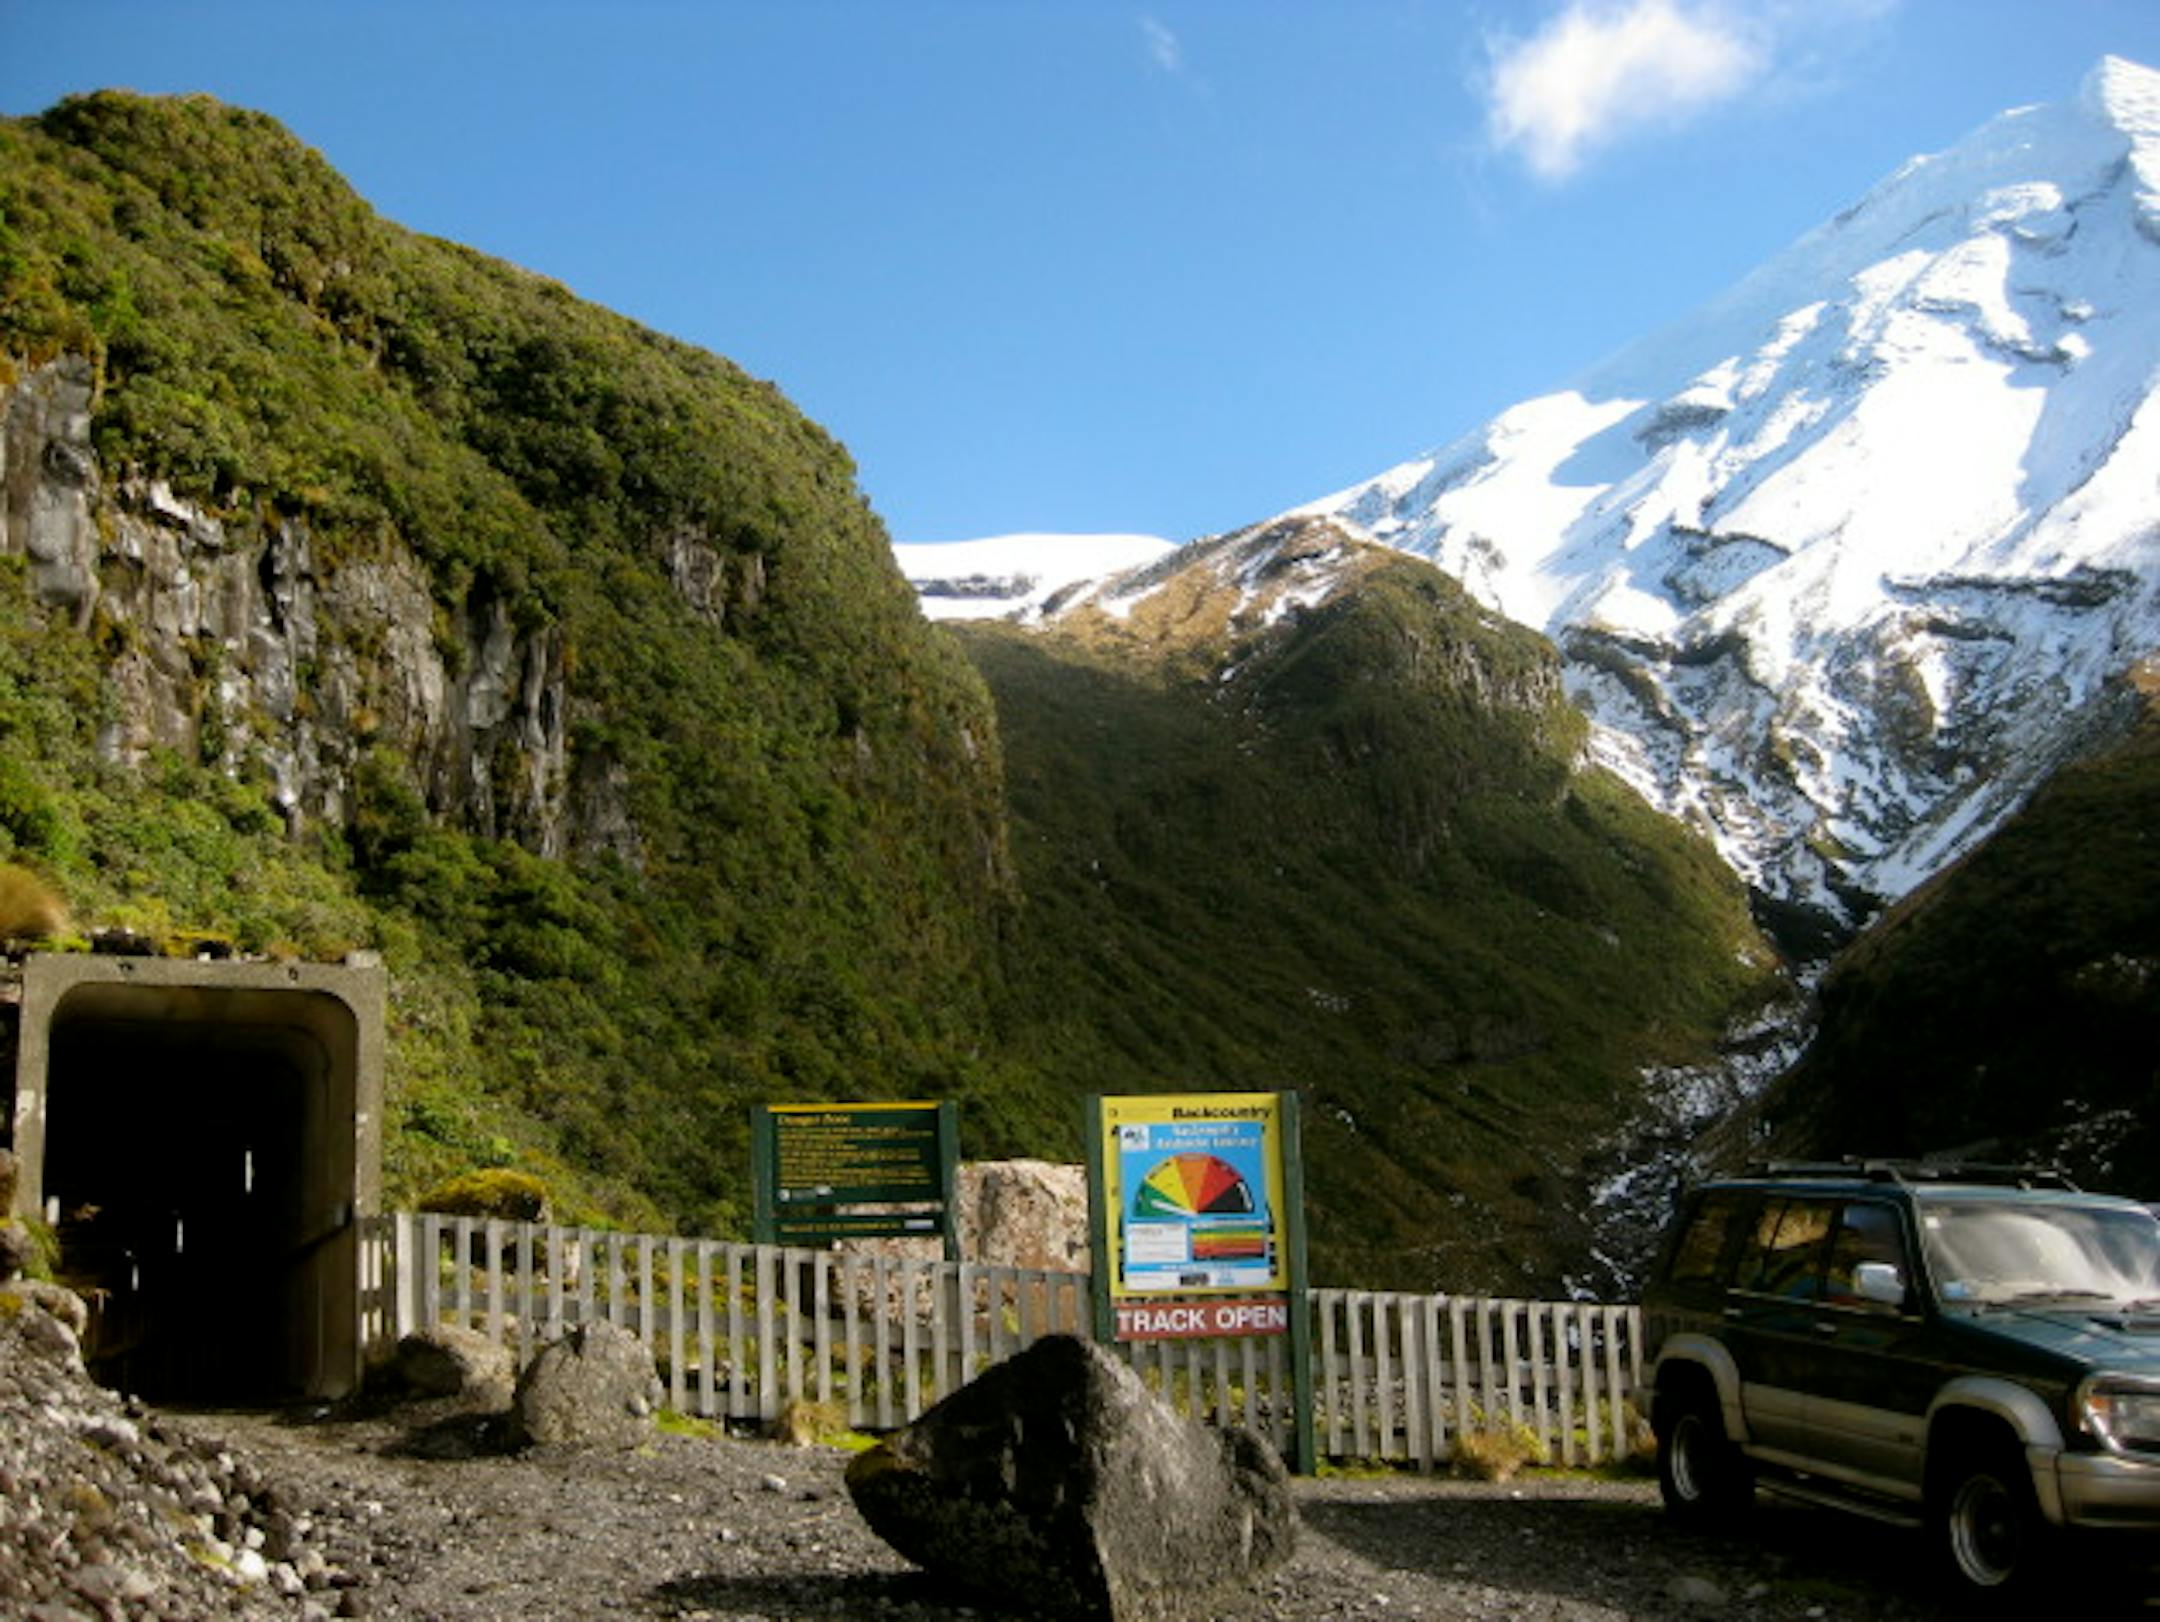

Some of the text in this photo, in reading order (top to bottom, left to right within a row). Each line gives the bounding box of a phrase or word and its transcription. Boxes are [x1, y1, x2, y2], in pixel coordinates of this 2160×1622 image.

[1172, 1106, 1271, 1120] Backcountry
[1117, 1304, 1288, 1333] TRACK OPEN
